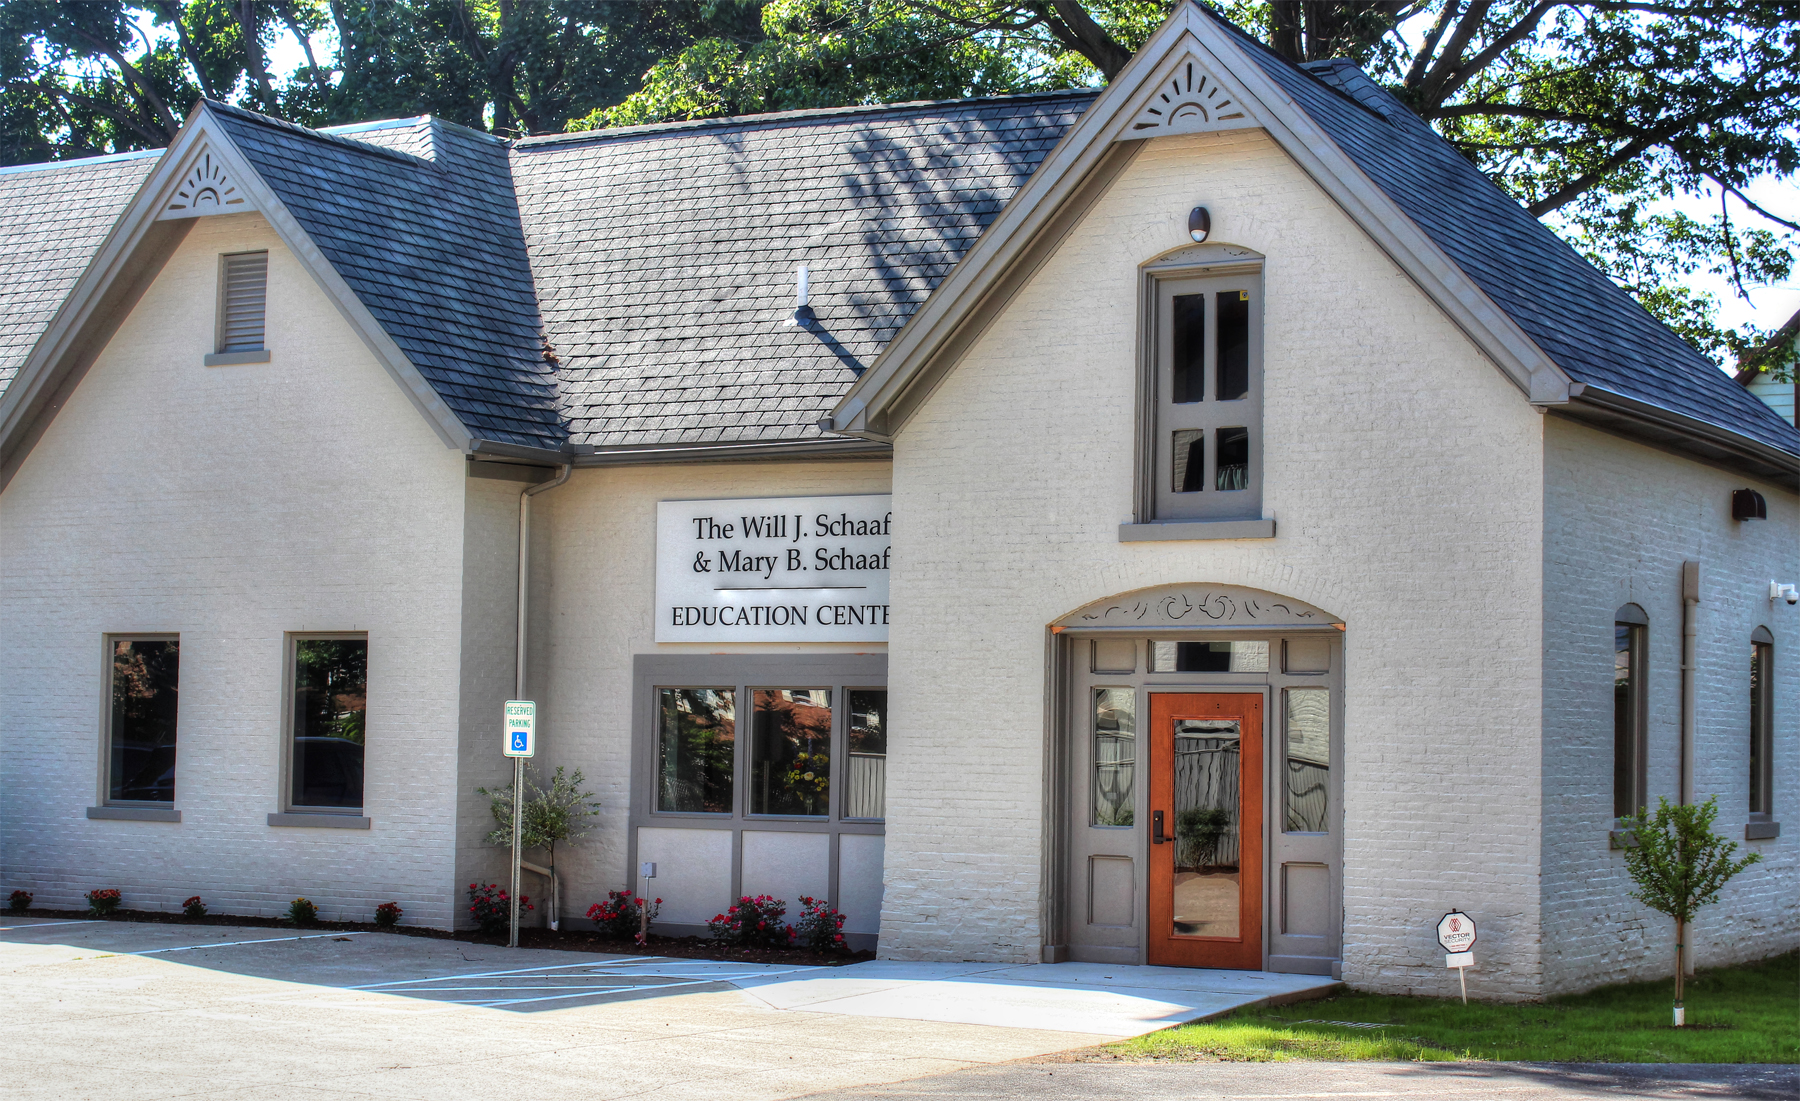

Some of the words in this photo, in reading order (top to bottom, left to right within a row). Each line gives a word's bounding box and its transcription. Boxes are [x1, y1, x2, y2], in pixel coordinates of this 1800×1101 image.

[692, 517, 734, 540] The
[741, 515, 787, 538] Will
[793, 515, 808, 542] J.
[815, 512, 892, 536] Schaaf
[692, 550, 711, 573] &
[718, 550, 778, 579] Mary
[786, 549, 807, 571] B.
[814, 546, 891, 570] Schaaf
[671, 606, 808, 626] EDUCATION
[506, 706, 533, 715] RESERVED
[509, 719, 531, 728] PARKING
